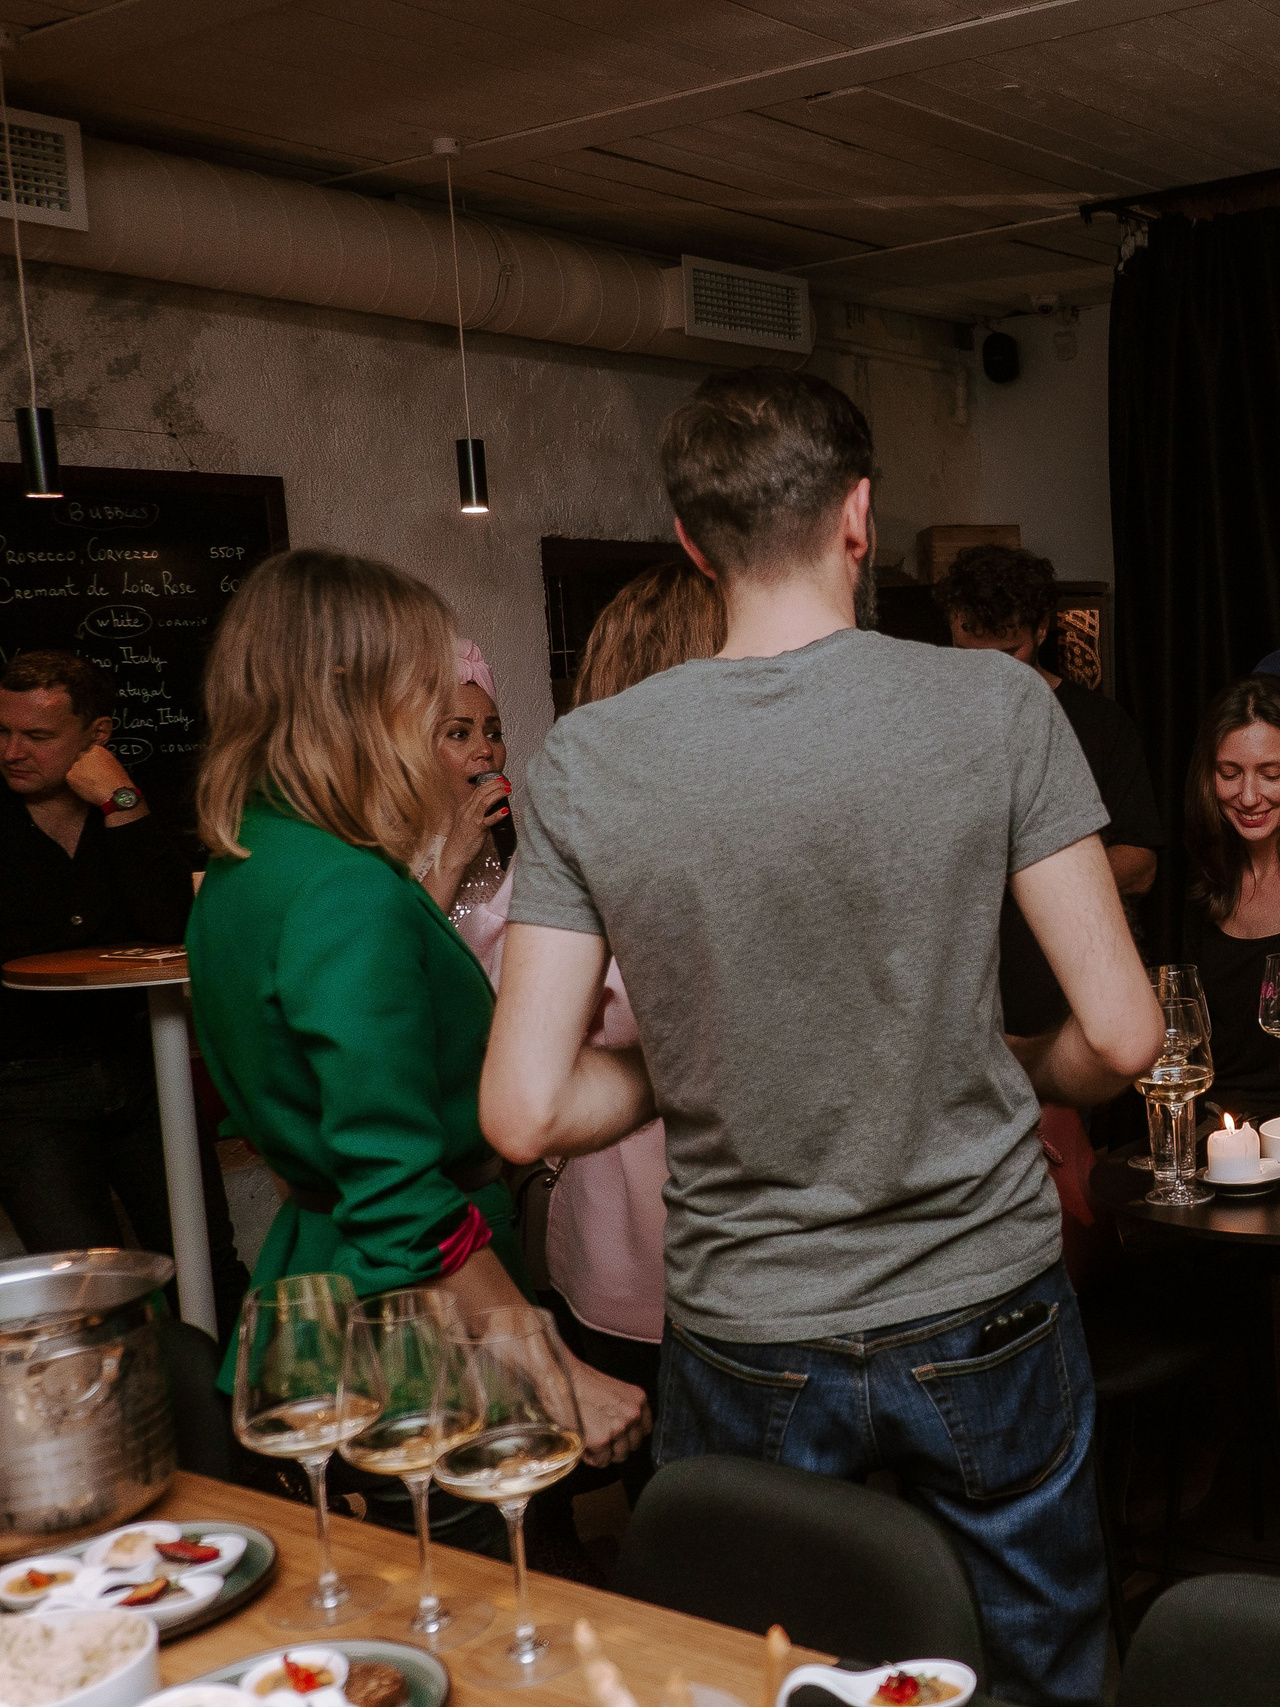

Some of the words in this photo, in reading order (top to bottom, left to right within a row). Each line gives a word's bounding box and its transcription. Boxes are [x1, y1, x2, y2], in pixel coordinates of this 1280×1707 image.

[87, 573, 110, 595] de
[97, 609, 145, 628] white
[119, 646, 168, 673] Italy
[156, 707, 195, 732] Italy
